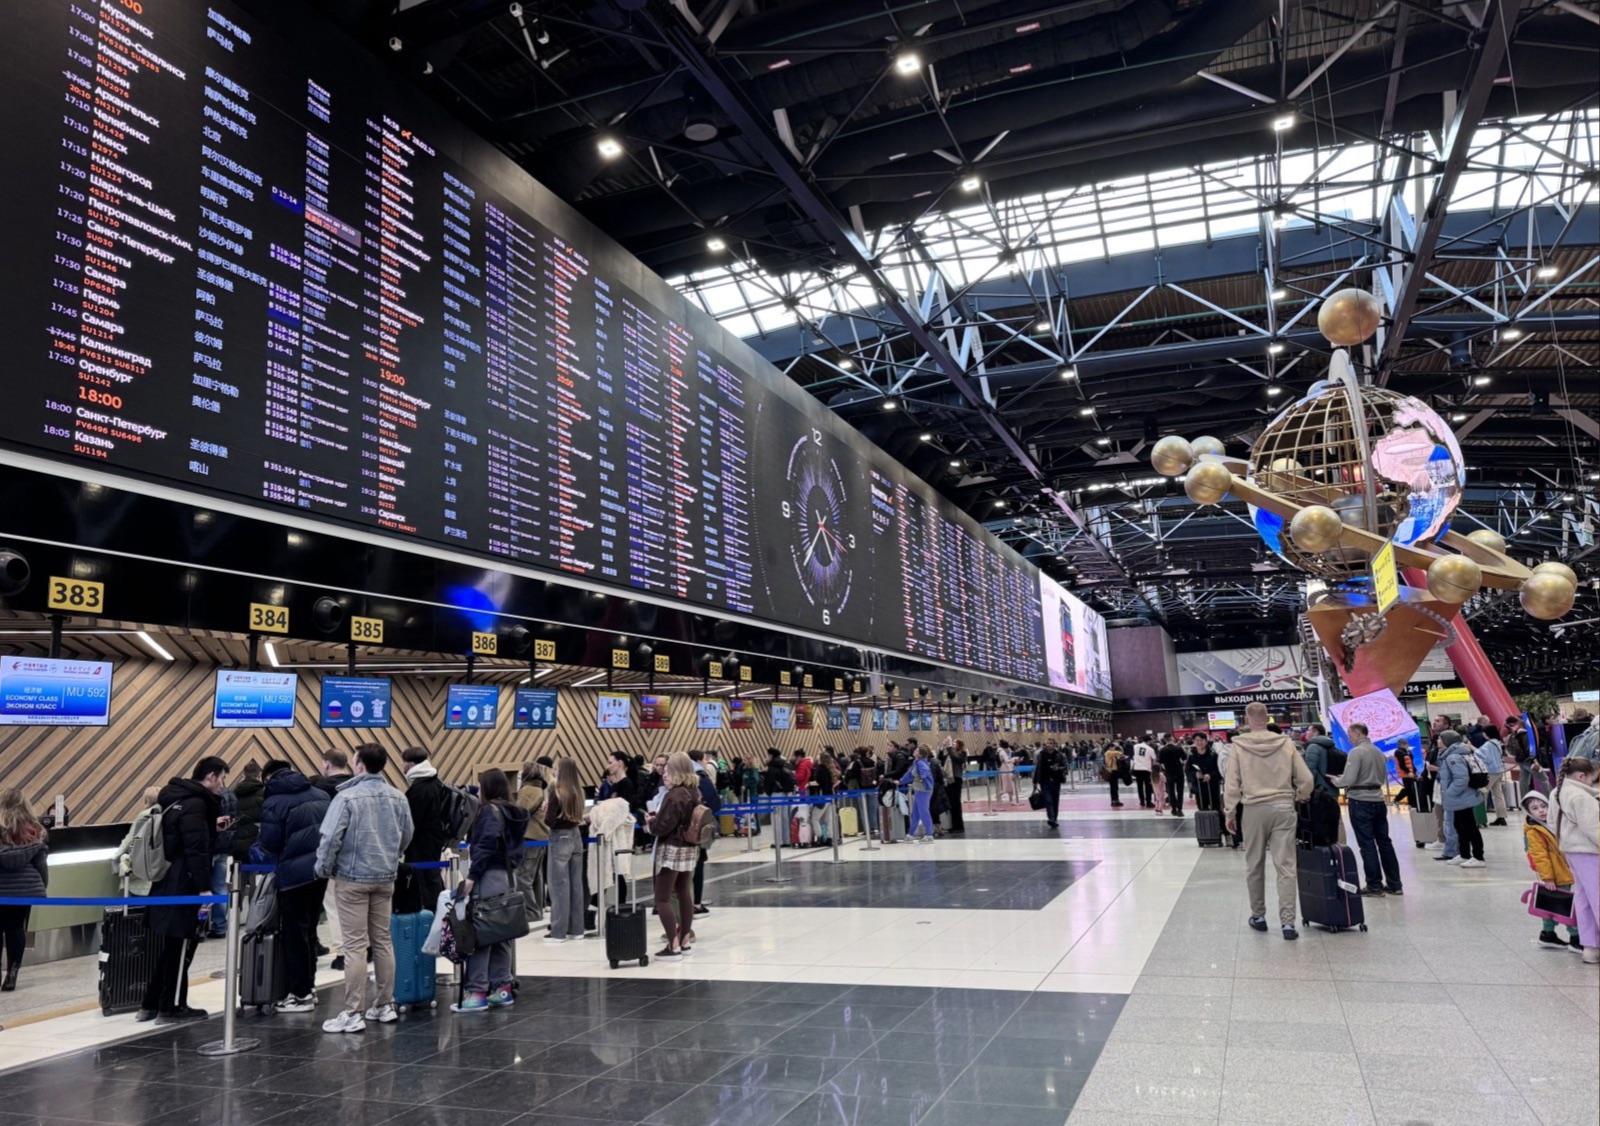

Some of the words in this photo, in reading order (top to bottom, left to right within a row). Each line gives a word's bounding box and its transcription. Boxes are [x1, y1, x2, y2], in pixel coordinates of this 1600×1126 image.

[100, 0, 154, 39] Мурманск
[69, 26, 94, 46] 17:05
[98, 41, 139, 73] Ижевск
[70, 4, 96, 24] 17:00
[99, 20, 186, 80] Южно-Сахалинск
[67, 48, 92, 68] 17:05
[96, 63, 131, 89] Пекин
[69, 83, 91, 99] 20:10
[64, 92, 91, 112] 17:10
[93, 107, 150, 145] Челябинск
[94, 86, 160, 128] Архангельск
[63, 115, 89, 134] 17:10
[92, 129, 128, 155] Минск
[61, 138, 88, 157] 17:15
[91, 151, 153, 191] Н.Новгород
[60, 160, 86, 179] 17:20
[89, 173, 176, 222] Шарм-эль-Шейх
[58, 184, 85, 202] 17:20
[88, 196, 193, 252] Петропавловск-Кмч
[55, 231, 82, 248] 17:30
[85, 243, 132, 269] Апатиты
[57, 207, 83, 225] 17:25
[87, 220, 175, 264] Санкт-Петербург
[54, 254, 81, 271] 17:30
[84, 265, 127, 289] Самара
[52, 278, 79, 295] 17:35
[83, 288, 121, 310] Пермь
[51, 302, 78, 318] 17:45
[82, 311, 125, 335] Самара
[53, 340, 76, 353] 19:45
[80, 348, 112, 364] FV6313
[114, 359, 145, 375] SU6313
[80, 335, 152, 368] Калининград
[48, 350, 75, 366] 17:50
[79, 359, 133, 383] Оренбург
[380, 368, 406, 386] 19:00
[78, 386, 122, 409] 18:00
[45, 400, 72, 414] 18:00
[76, 407, 168, 440] Санкт-Петербург
[43, 424, 71, 439] 18:05
[75, 431, 115, 450] Казань
[811, 427, 823, 446] 12
[782, 501, 791, 518] 9
[849, 534, 856, 549] 3
[53, 582, 100, 607] 383
[253, 608, 287, 628] 384
[353, 621, 381, 639] 385
[822, 609, 831, 625] 6
[474, 635, 496, 651] 386
[536, 643, 554, 657] 387
[614, 652, 628, 665] 388
[656, 658, 668, 670] 389
[66, 686, 85, 697] MU
[87, 688, 106, 698] 592
[264, 695, 277, 703] MU
[279, 696, 292, 704] 592
[1215, 695, 1254, 704] ВЫХОДЫ
[1271, 691, 1314, 701] ПОСАДКУ
[1404, 685, 1419, 693] 124
